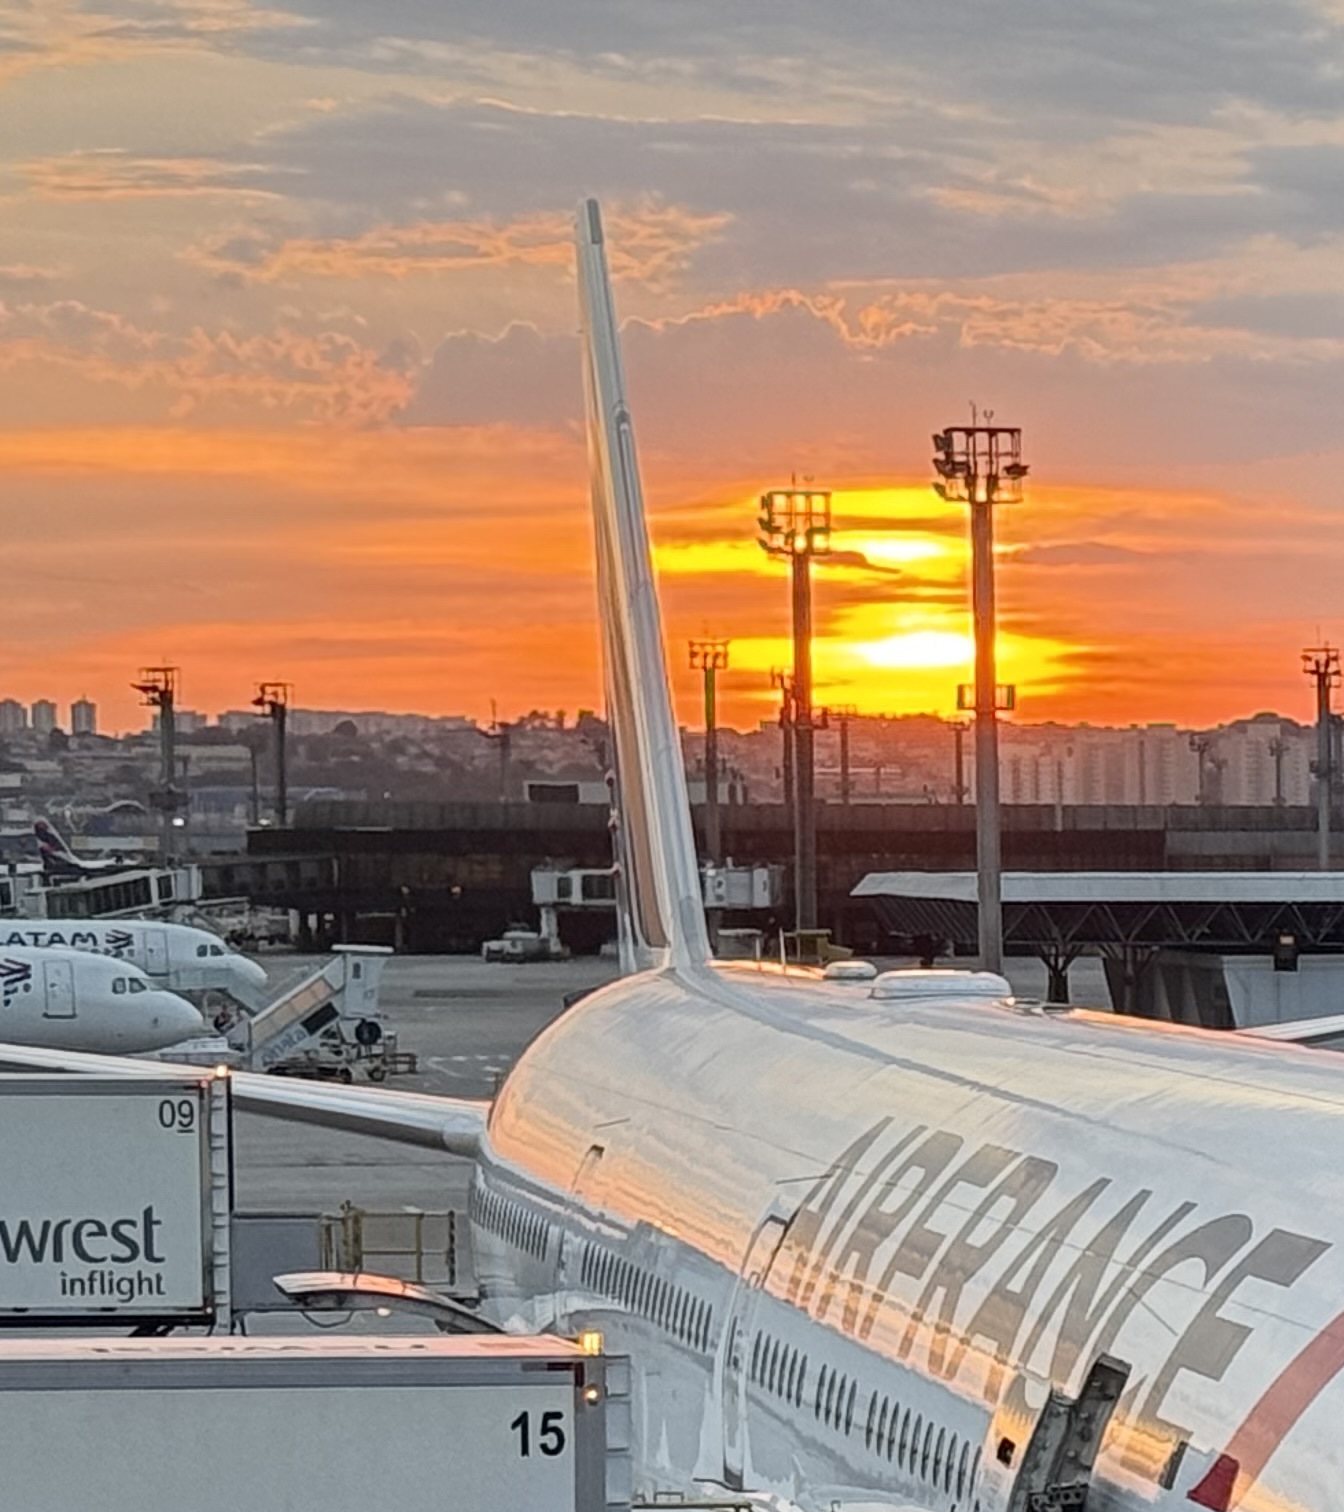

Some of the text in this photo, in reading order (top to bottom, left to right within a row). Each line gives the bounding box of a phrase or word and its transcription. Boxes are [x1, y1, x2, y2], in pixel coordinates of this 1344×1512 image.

[0, 932, 97, 948] ATAM
[159, 1100, 194, 1129] 09
[60, 1270, 166, 1303] inflight
[782, 1116, 1334, 1490] AIRFRANCE
[511, 1411, 565, 1457] 15
